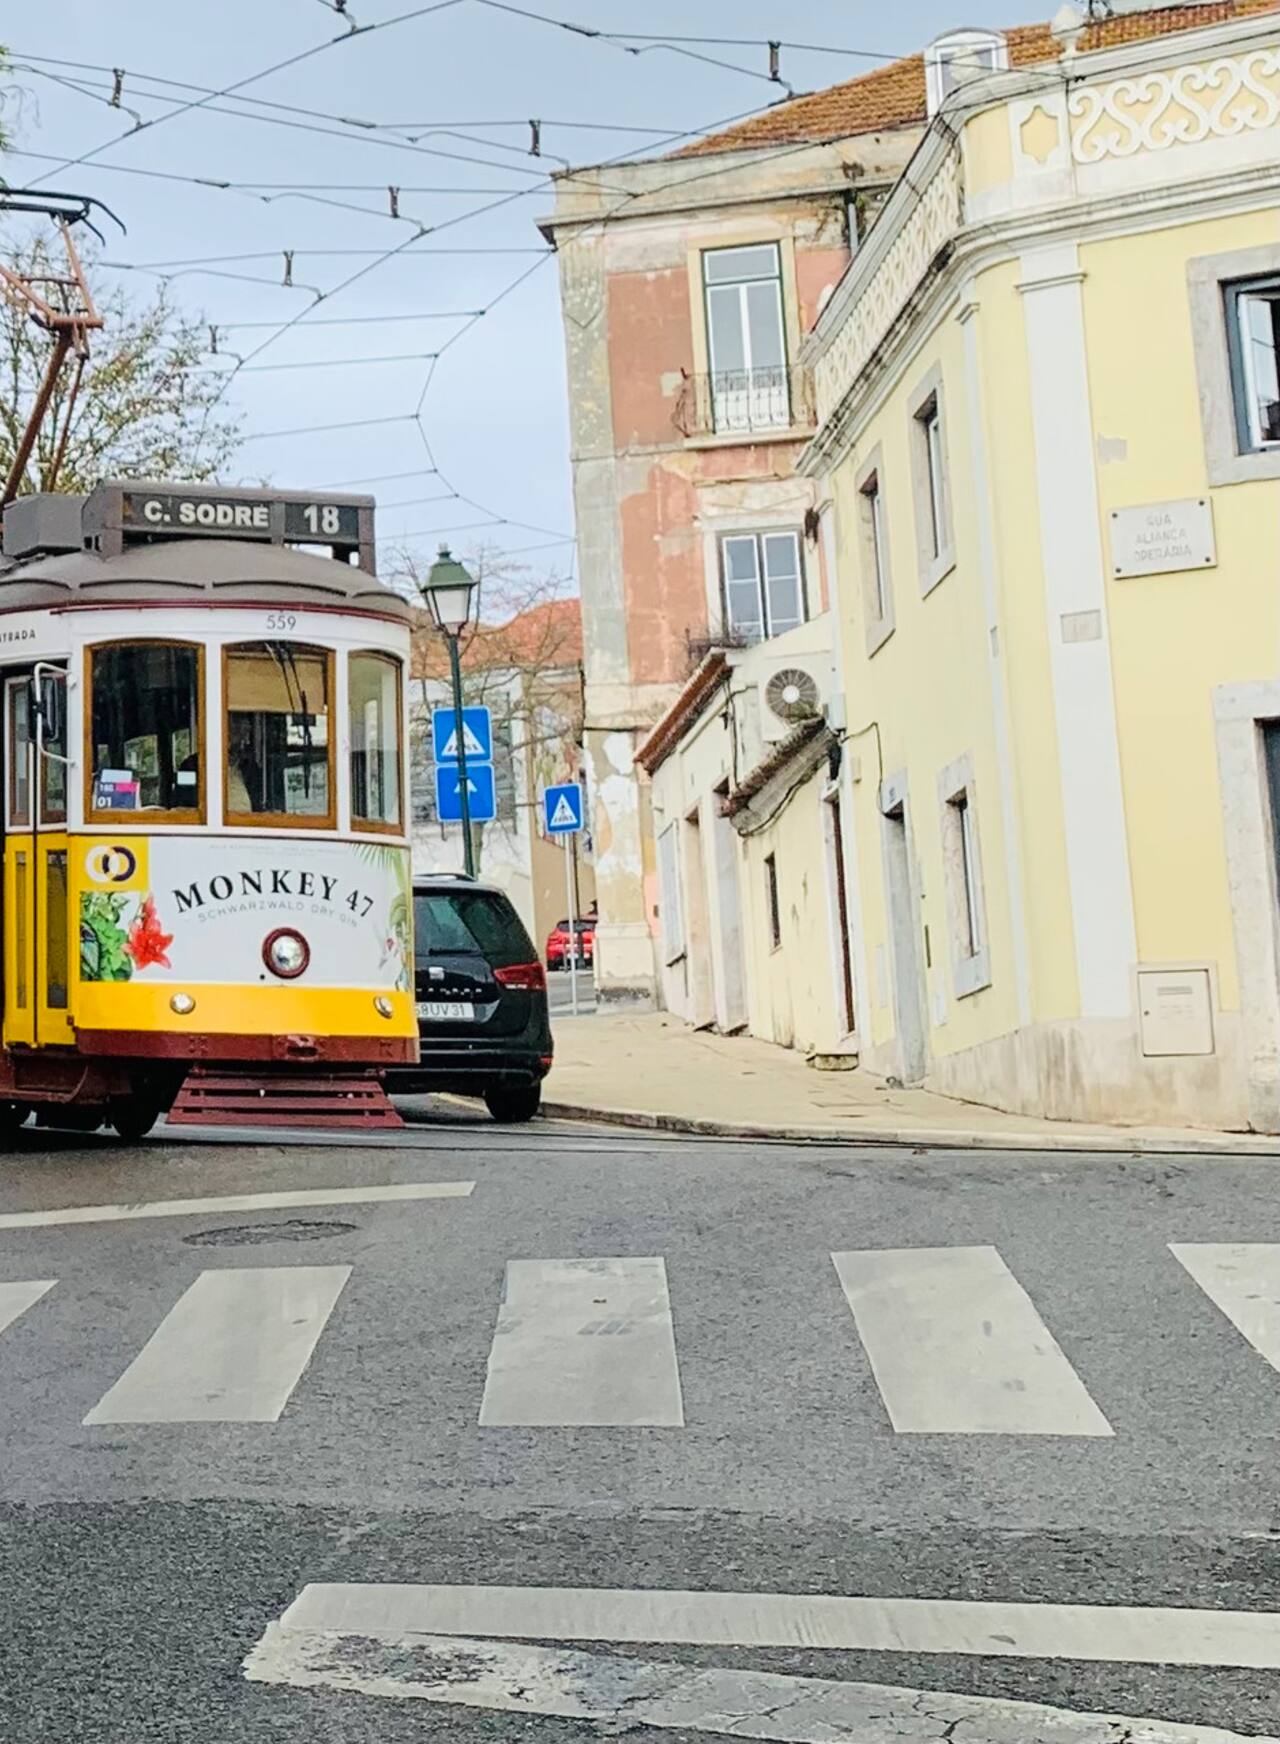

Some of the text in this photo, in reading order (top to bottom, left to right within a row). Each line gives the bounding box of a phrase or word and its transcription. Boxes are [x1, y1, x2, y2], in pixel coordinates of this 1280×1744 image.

[144, 500, 170, 522] C.
[303, 505, 340, 534] 18
[267, 615, 296, 630] 559
[97, 796, 112, 807] 01
[172, 869, 374, 917] MONKEY 47
[197, 901, 305, 923] SCHWARZWALD
[311, 904, 337, 921] DRY
